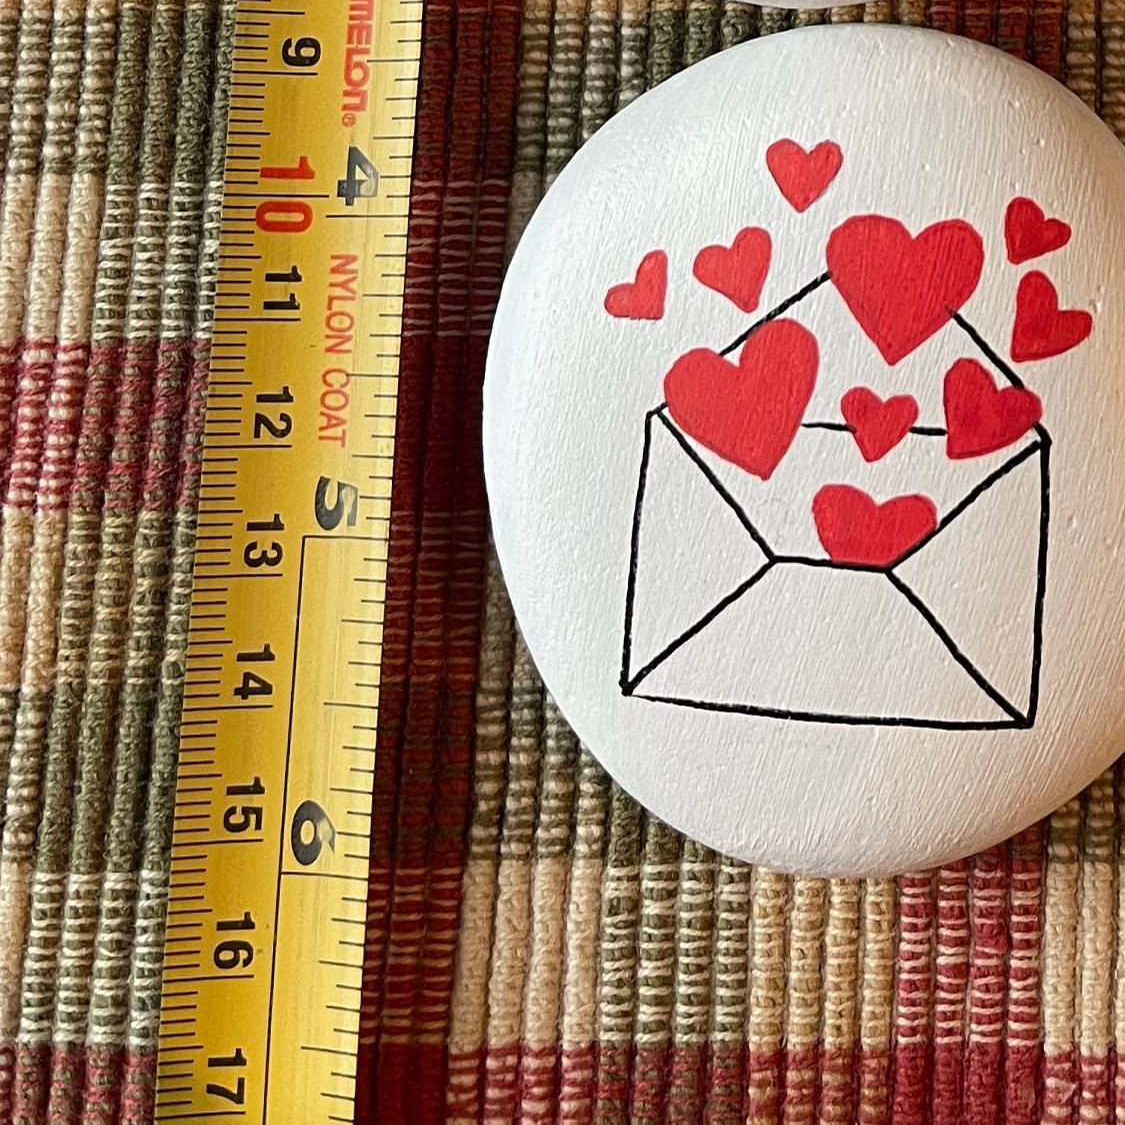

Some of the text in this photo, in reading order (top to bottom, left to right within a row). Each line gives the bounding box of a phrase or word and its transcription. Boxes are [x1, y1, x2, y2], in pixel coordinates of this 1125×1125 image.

[281, 37, 322, 67] 9
[255, 156, 316, 233] 10
[336, 146, 379, 206] 4
[263, 265, 302, 311] 11
[318, 253, 359, 448] NYLON COAT
[253, 385, 294, 439] 12
[314, 476, 359, 531] 5
[243, 513, 285, 568] 13
[233, 643, 276, 700] 14
[223, 776, 266, 833] 15
[290, 800, 336, 866] 6
[213, 911, 256, 970] 16
[206, 1047, 247, 1104] 17
